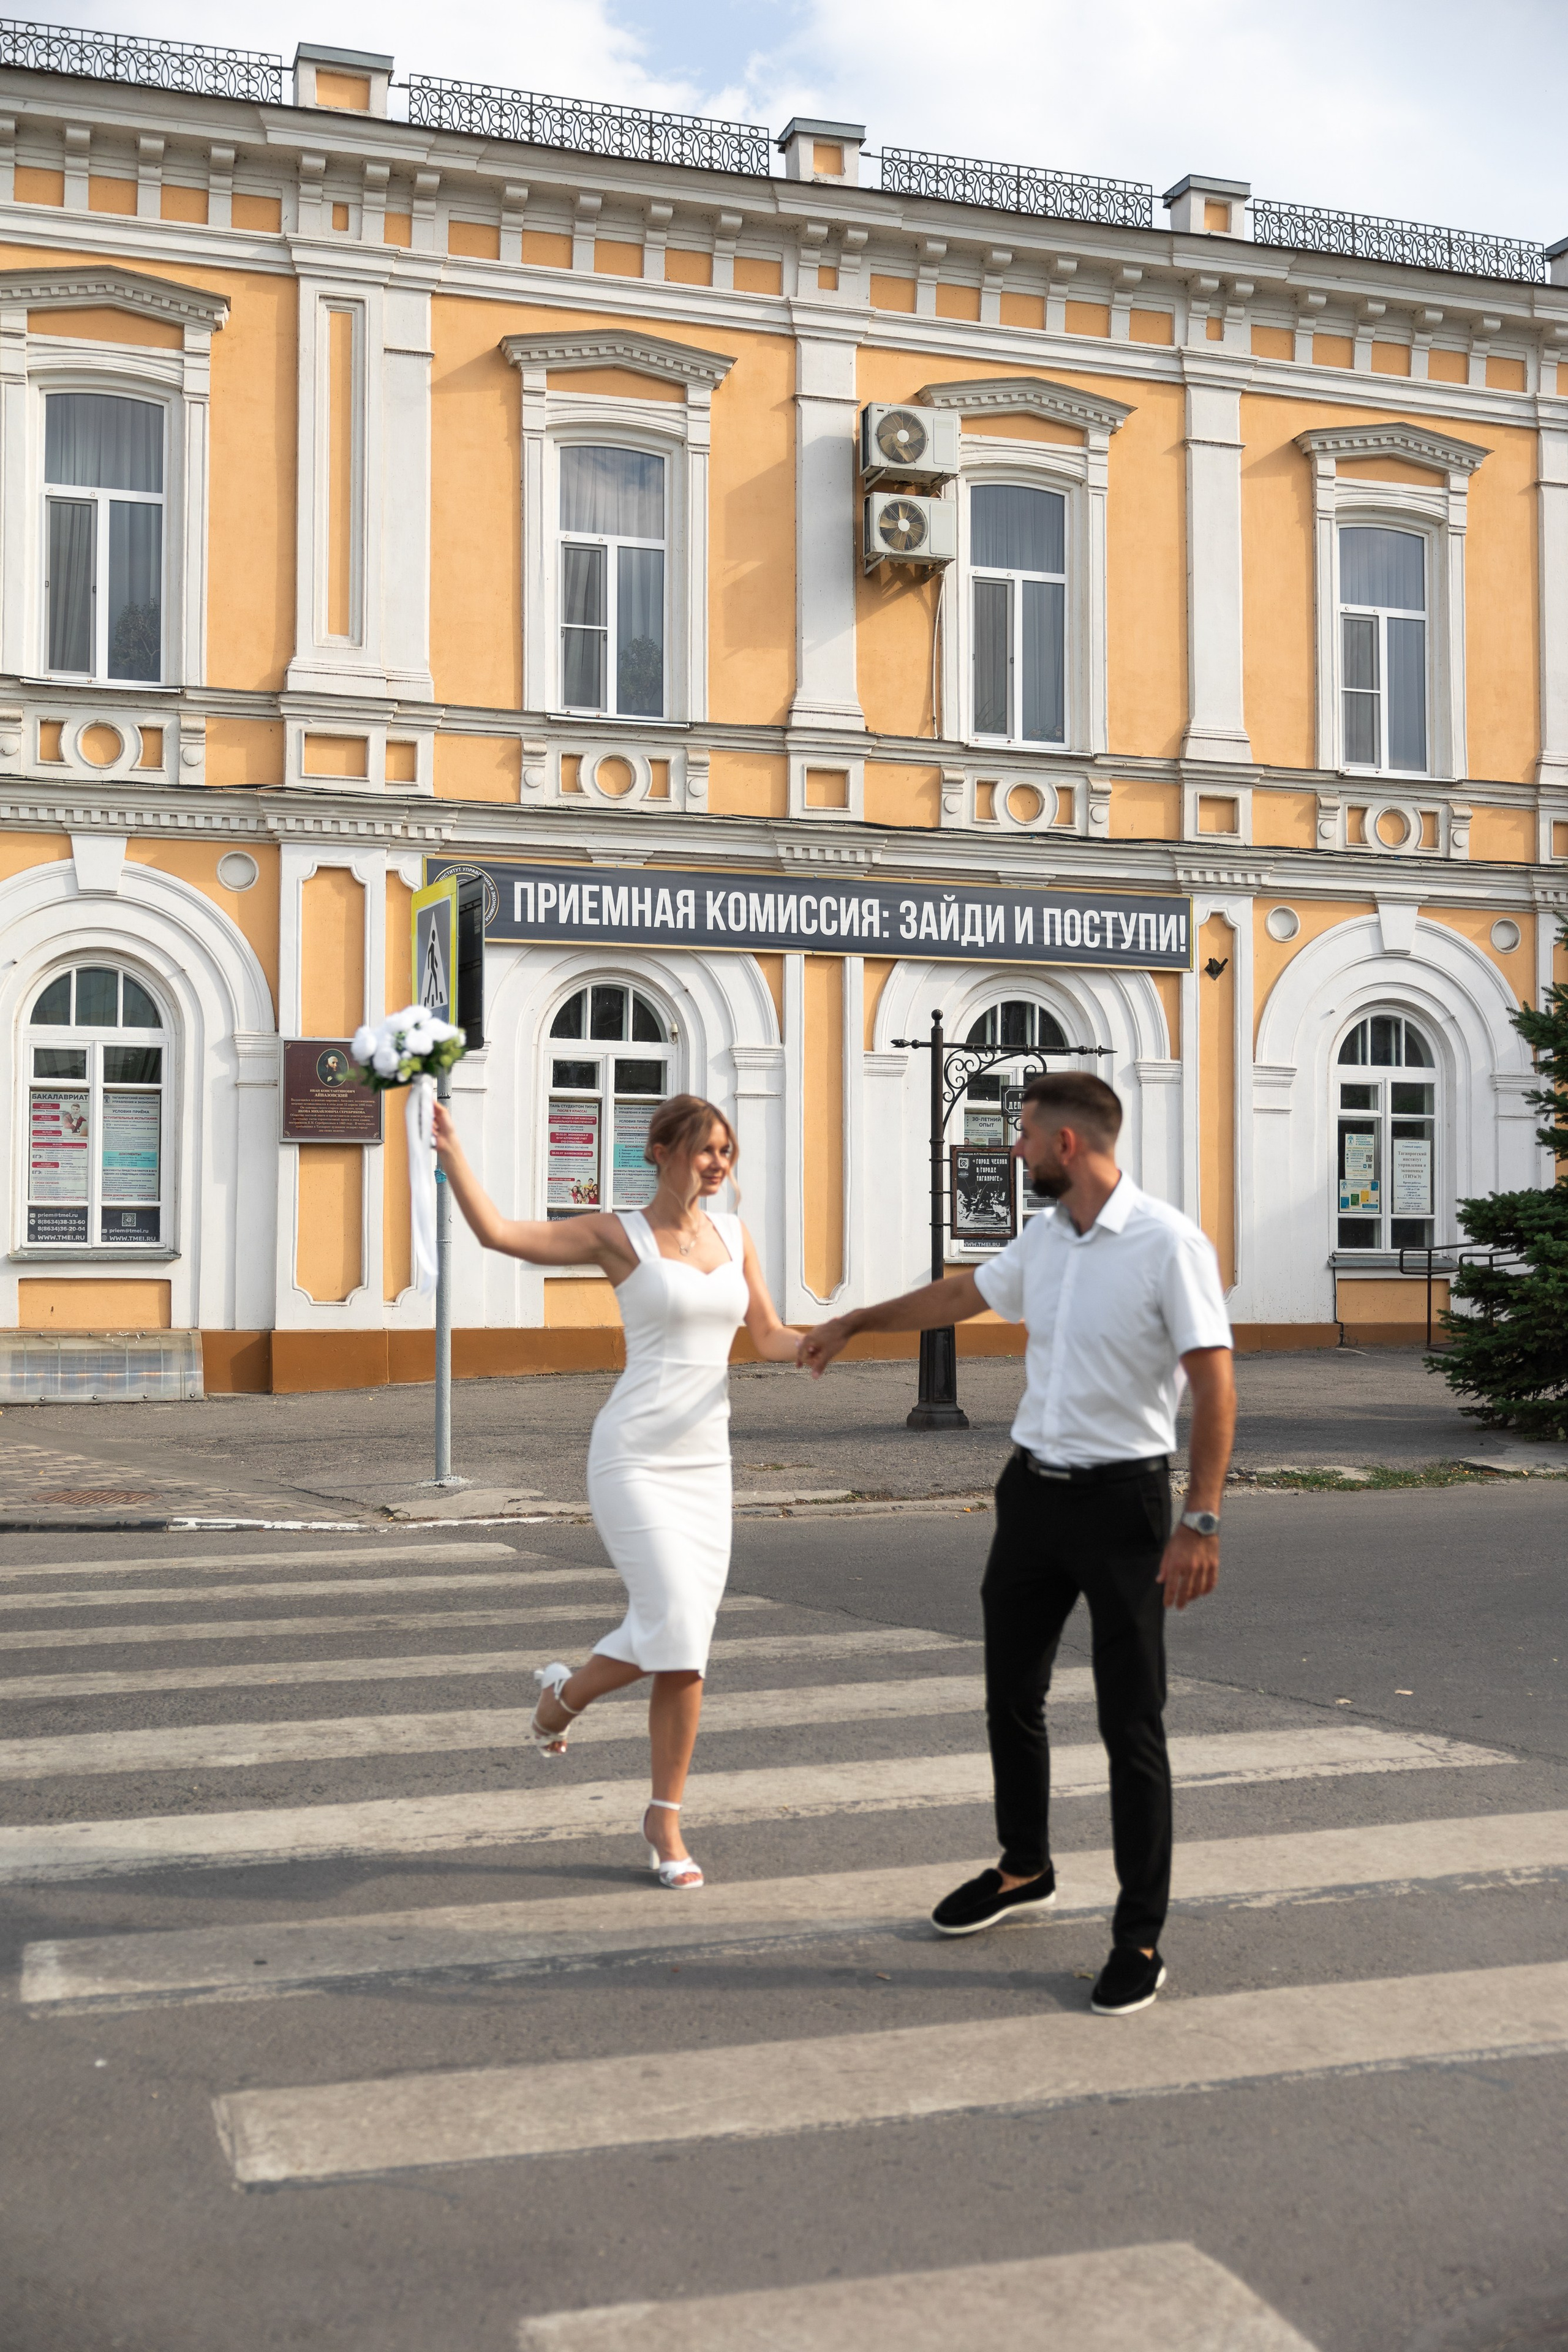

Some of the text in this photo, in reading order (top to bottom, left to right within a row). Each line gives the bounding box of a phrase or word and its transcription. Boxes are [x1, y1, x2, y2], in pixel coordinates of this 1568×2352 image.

[484, 891, 497, 922] ЭКОНОМИКИ
[514, 881, 1186, 952] ПРИЕМНАЯ КОМИССИЯ: ЗАЙДИ И ПОСТУПИ!
